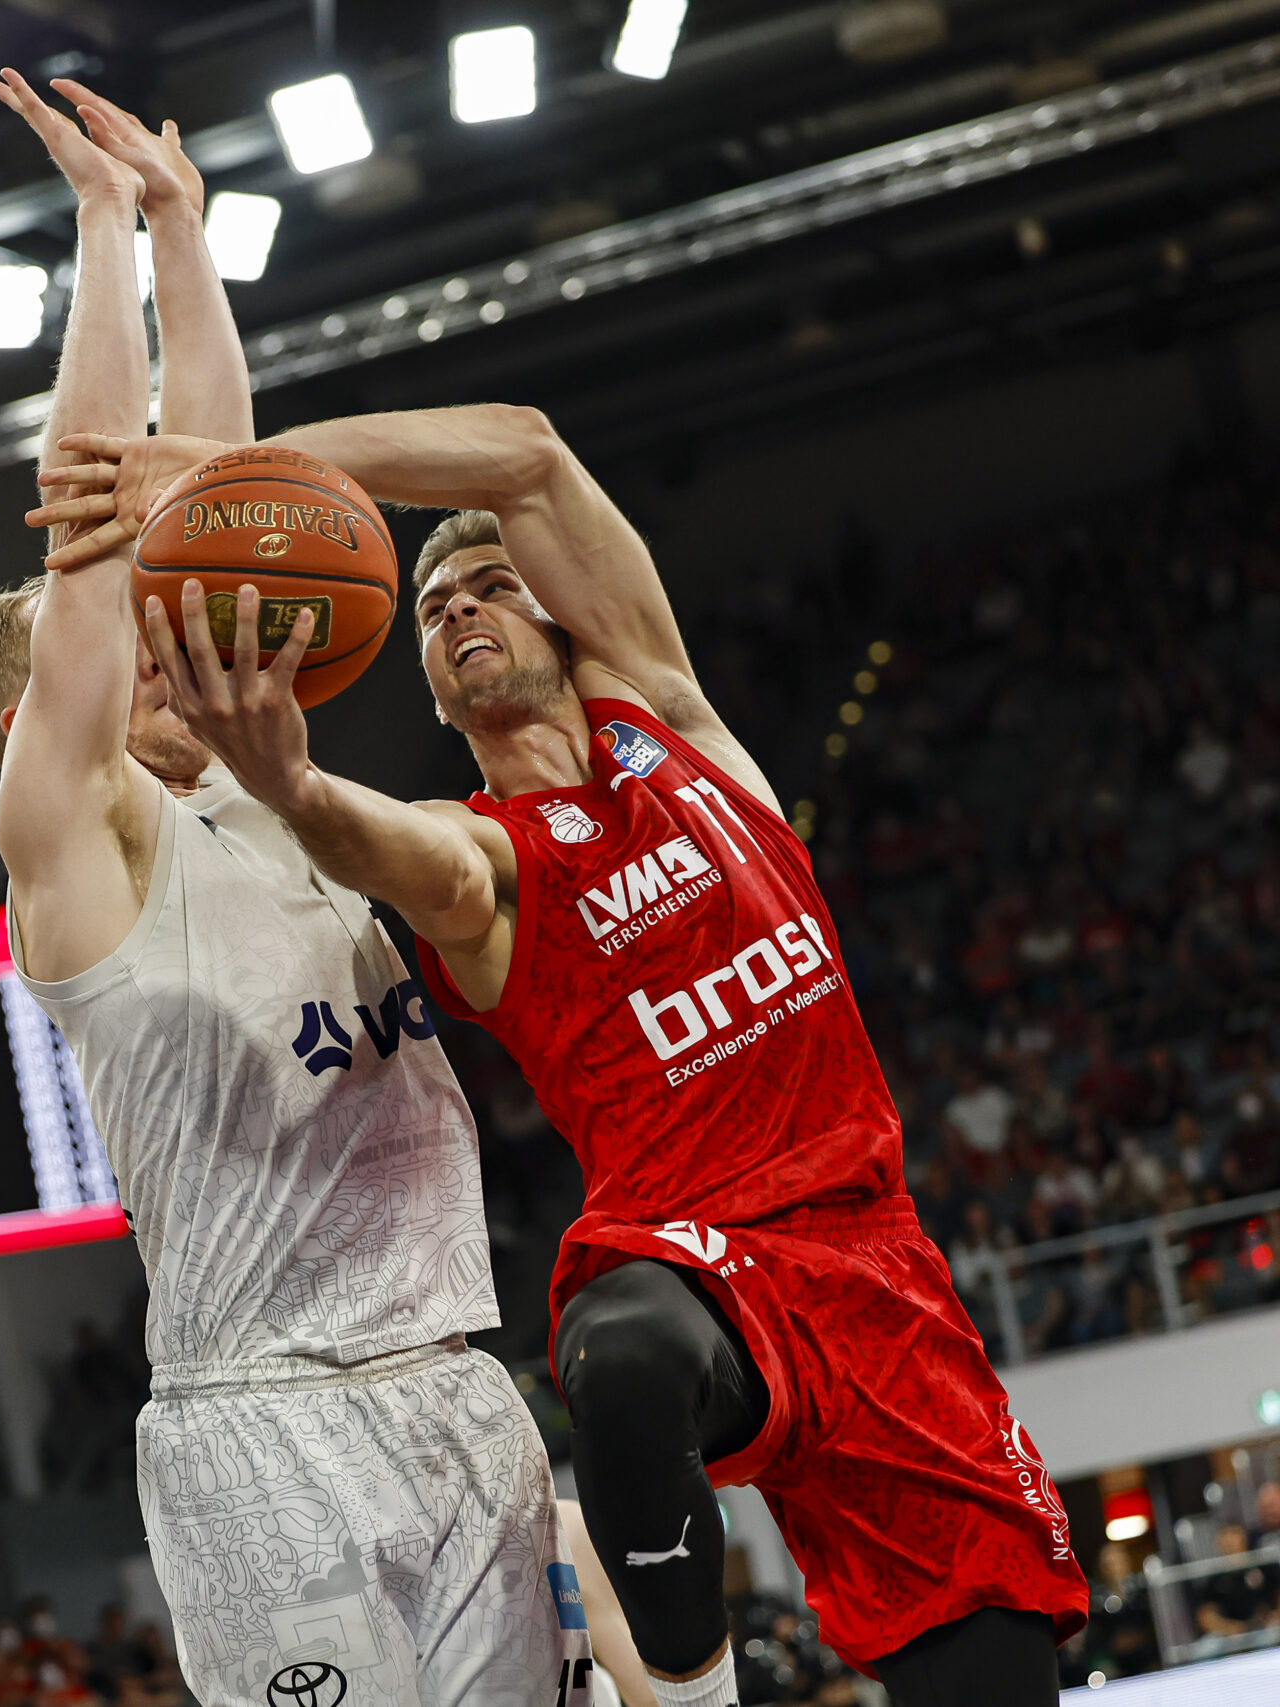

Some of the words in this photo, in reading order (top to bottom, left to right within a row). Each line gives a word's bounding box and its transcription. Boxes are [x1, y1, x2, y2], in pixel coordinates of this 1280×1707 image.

[183, 501, 359, 553] SPALDING
[626, 743, 660, 773] BBL
[598, 868, 723, 957] VERSICHERUNG
[665, 1020, 768, 1088] Excellence
[766, 1006, 786, 1028] in
